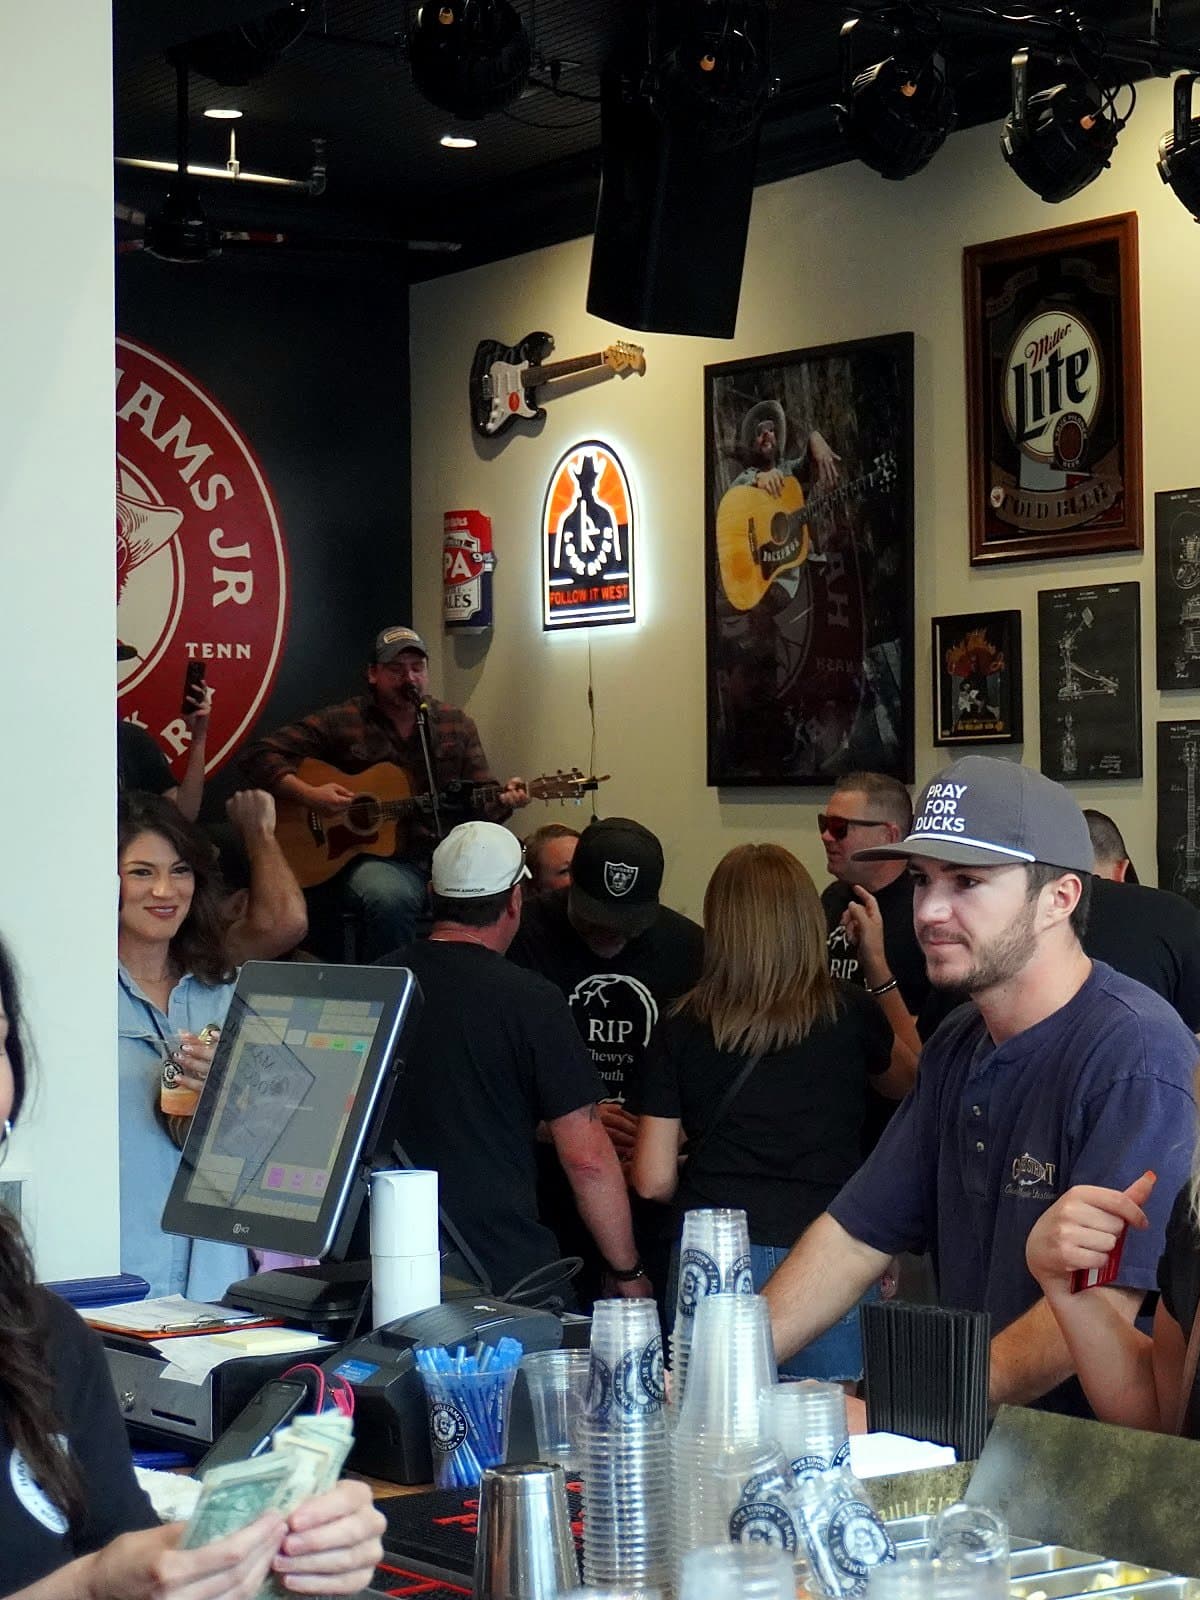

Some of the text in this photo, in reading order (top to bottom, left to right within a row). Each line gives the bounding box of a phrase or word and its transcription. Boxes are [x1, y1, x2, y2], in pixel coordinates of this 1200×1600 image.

[1024, 323, 1072, 368] Miller
[1011, 347, 1092, 444] Lite
[208, 527, 254, 608] JR
[549, 585, 628, 605] FOLLOW IT WEST
[185, 642, 251, 660] TENN
[926, 783, 967, 799] PRAY
[924, 800, 957, 815] FOR
[915, 816, 965, 833] DUCKS
[830, 958, 859, 980] RIP
[588, 1018, 633, 1043] RIP
